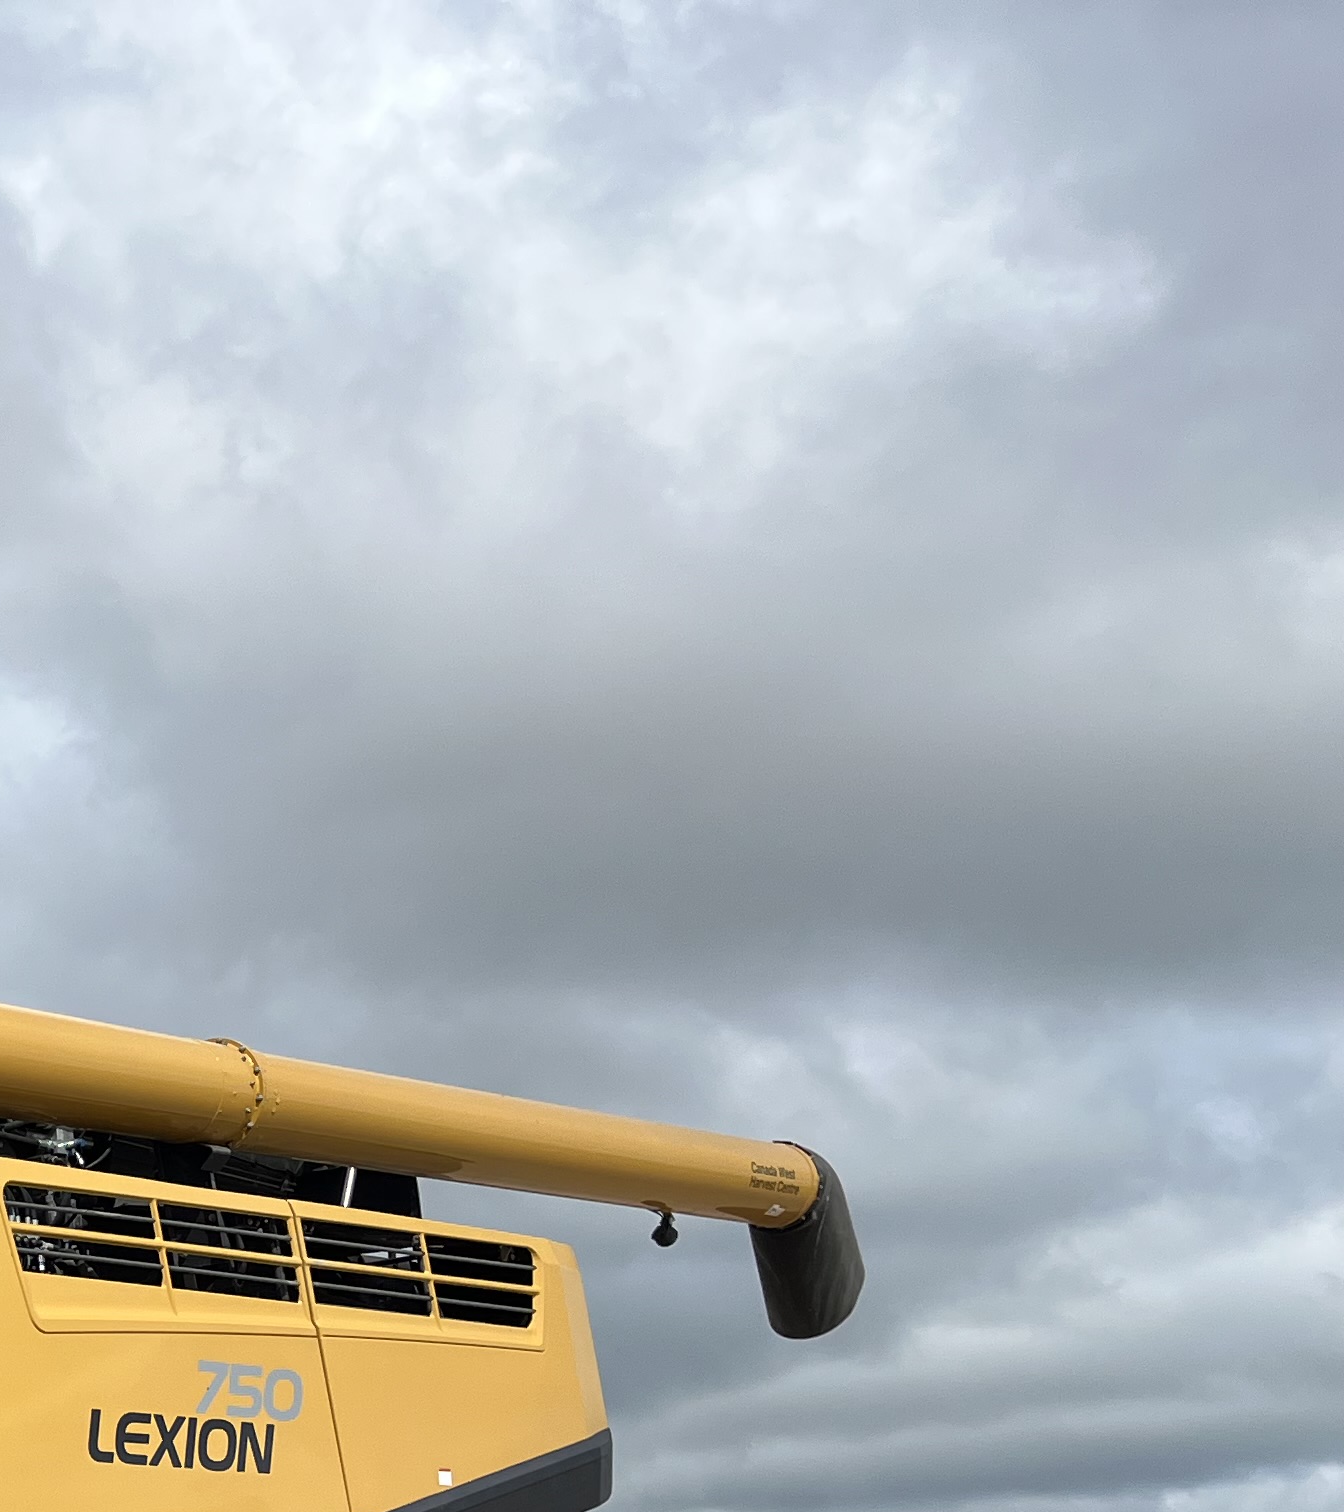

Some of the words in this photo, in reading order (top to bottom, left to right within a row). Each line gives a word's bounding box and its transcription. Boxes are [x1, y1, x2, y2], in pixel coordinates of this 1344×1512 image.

[749, 1175, 776, 1191] Harvest
[777, 1181, 800, 1195] Centre
[751, 1161, 777, 1177] Canada
[778, 1167, 795, 1180] West
[195, 1359, 304, 1421] 750
[88, 1408, 275, 1474] LEXION
